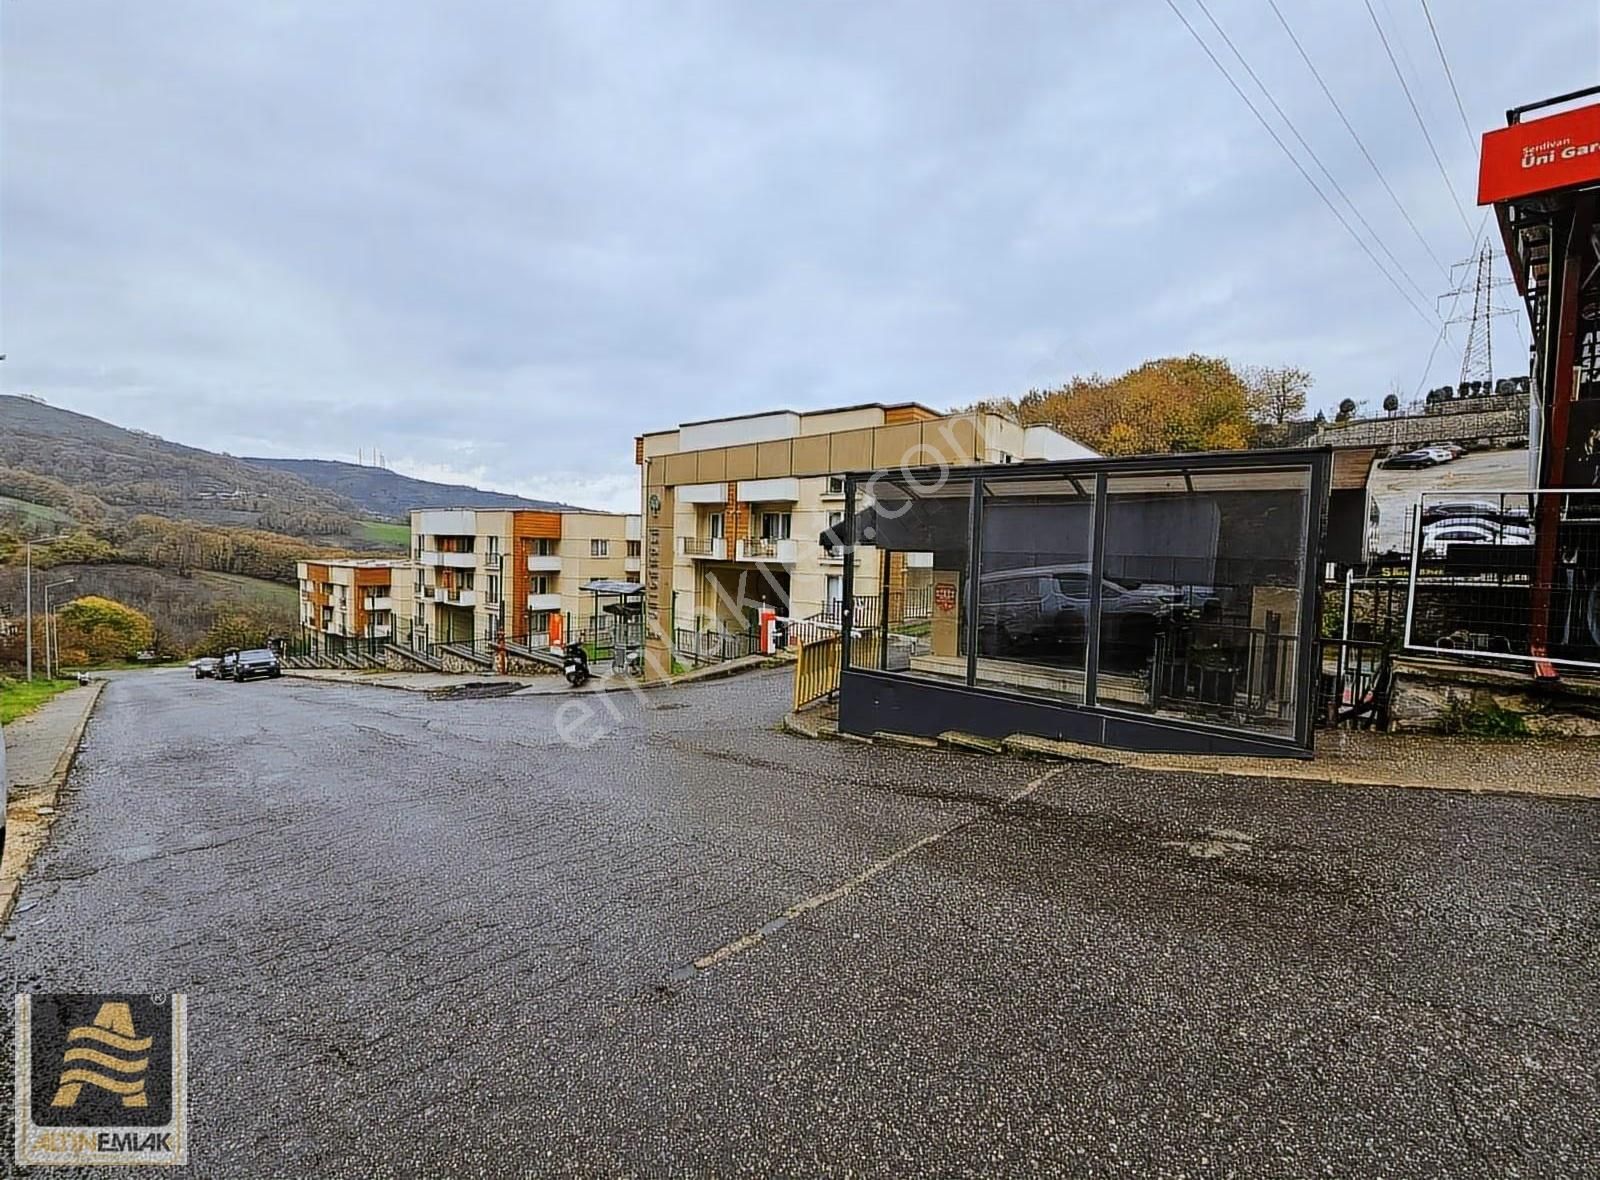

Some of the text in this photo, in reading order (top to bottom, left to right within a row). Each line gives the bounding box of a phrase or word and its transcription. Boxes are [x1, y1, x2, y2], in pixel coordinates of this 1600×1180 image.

[1521, 143, 1600, 168] Üni Gar
[1523, 138, 1570, 154] Serdivan
